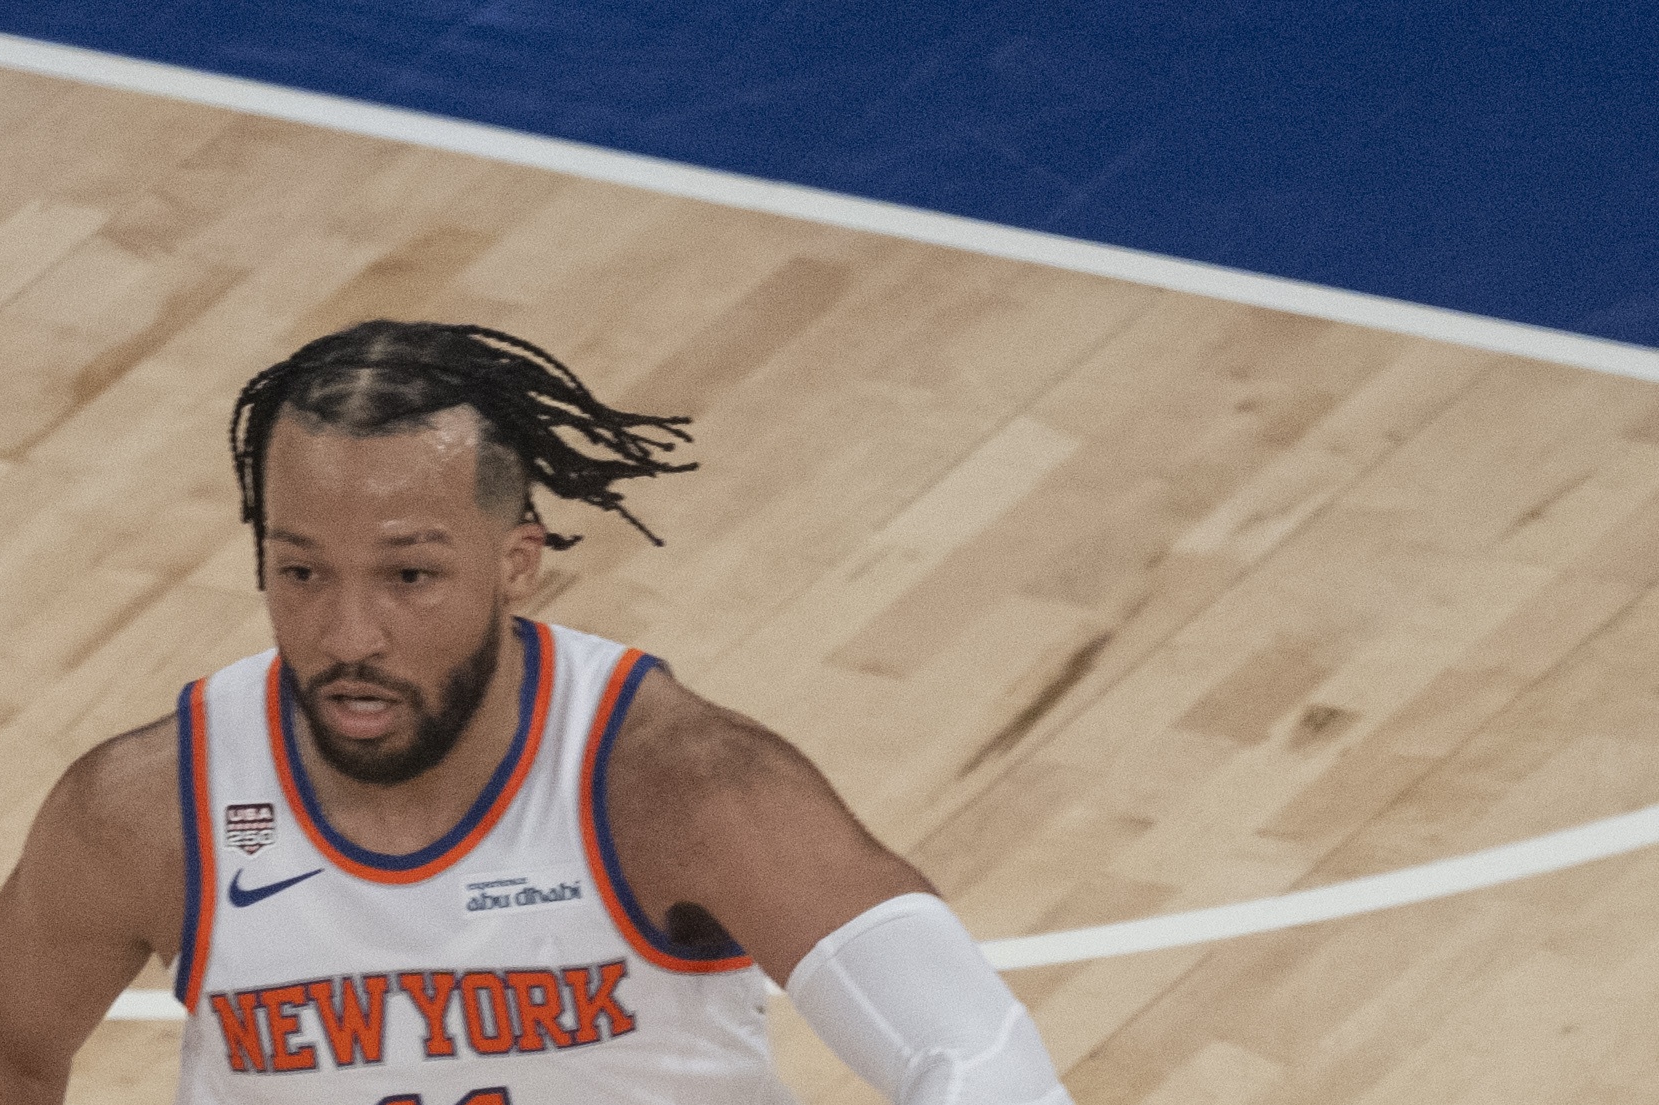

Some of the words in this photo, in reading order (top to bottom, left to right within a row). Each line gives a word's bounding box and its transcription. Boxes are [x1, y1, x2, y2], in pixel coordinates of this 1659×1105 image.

[466, 893, 511, 912] abu
[515, 880, 582, 906] dhabi
[209, 972, 390, 1074] NEW
[399, 959, 636, 1060] YORK
